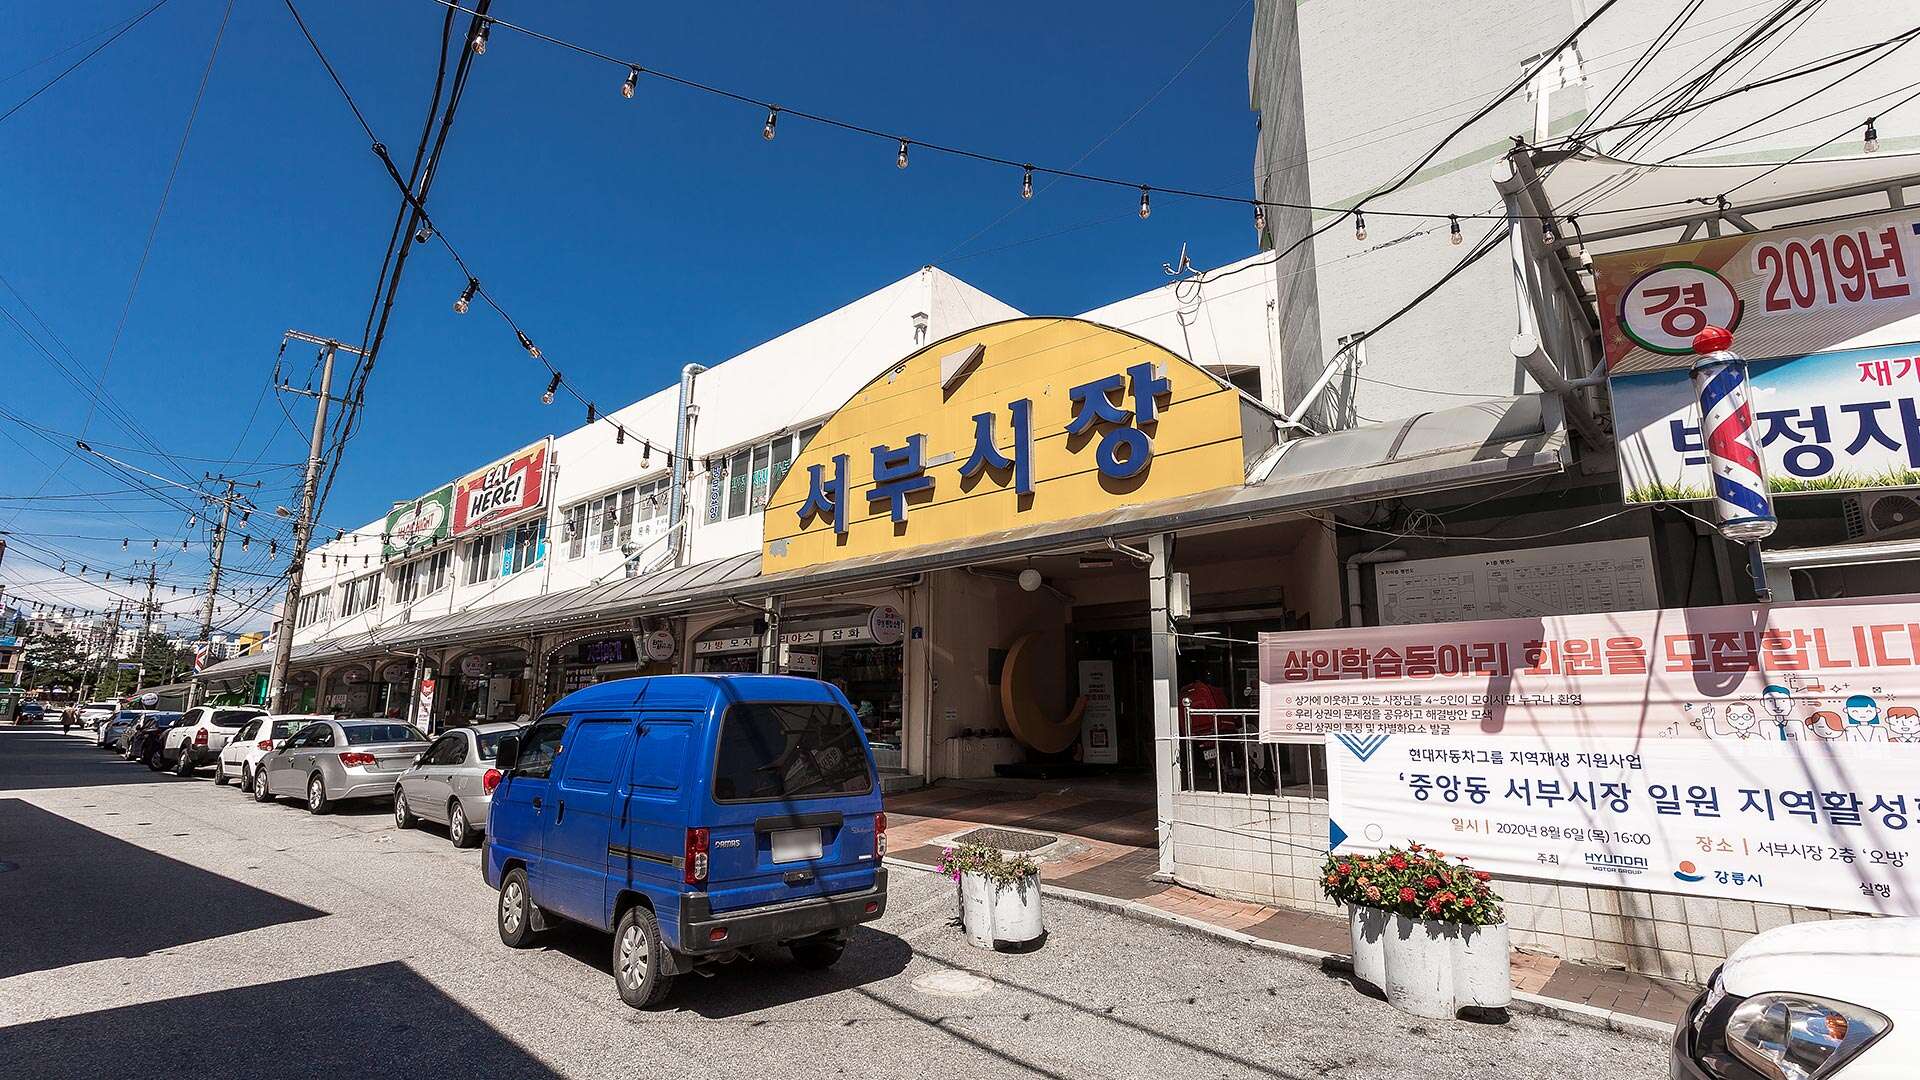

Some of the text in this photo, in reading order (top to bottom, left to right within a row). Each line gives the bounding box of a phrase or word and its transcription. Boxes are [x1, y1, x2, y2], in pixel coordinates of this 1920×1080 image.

[1757, 227, 1910, 312] 2019년
[1643, 282, 1707, 337] 경
[797, 361, 1172, 534] 서부시장
[483, 459, 515, 491] EAT
[471, 476, 522, 518] HERE!
[703, 628, 860, 650] 가방 모자 리야스 잡화
[1284, 642, 1508, 681] 상인학습동아리
[1523, 636, 1648, 676] 회원을
[1295, 694, 1582, 706] 상가에 이웃하고 있는 사장님들 4~5인이 모이시면 누구나 환영
[1295, 709, 1493, 721] 우리 상권의 문제점을 공유하고 해결방안 모색
[1296, 723, 1450, 735] 우리 상권의 특징 및 차별화요소 발굴
[1409, 748, 1642, 770] 현대자동차그룹 지역재생 지원사업
[1504, 777, 1632, 813] 서부시장
[1648, 784, 1721, 818] 일원
[1738, 788, 1920, 831] 지역활성
[1451, 817, 1651, 845] 일시 2020년 8월 6일 (목) 16:00
[1537, 853, 1559, 865] 주최
[1585, 852, 1648, 867] HYUNDAI
[1695, 835, 1734, 853] 장소
[1758, 842, 1823, 861] 서부시장
[1829, 847, 1856, 864] 2층
[1618, 867, 1642, 875] GROUP
[1714, 870, 1763, 887] 강릉시
[1859, 882, 1890, 898] 실행
